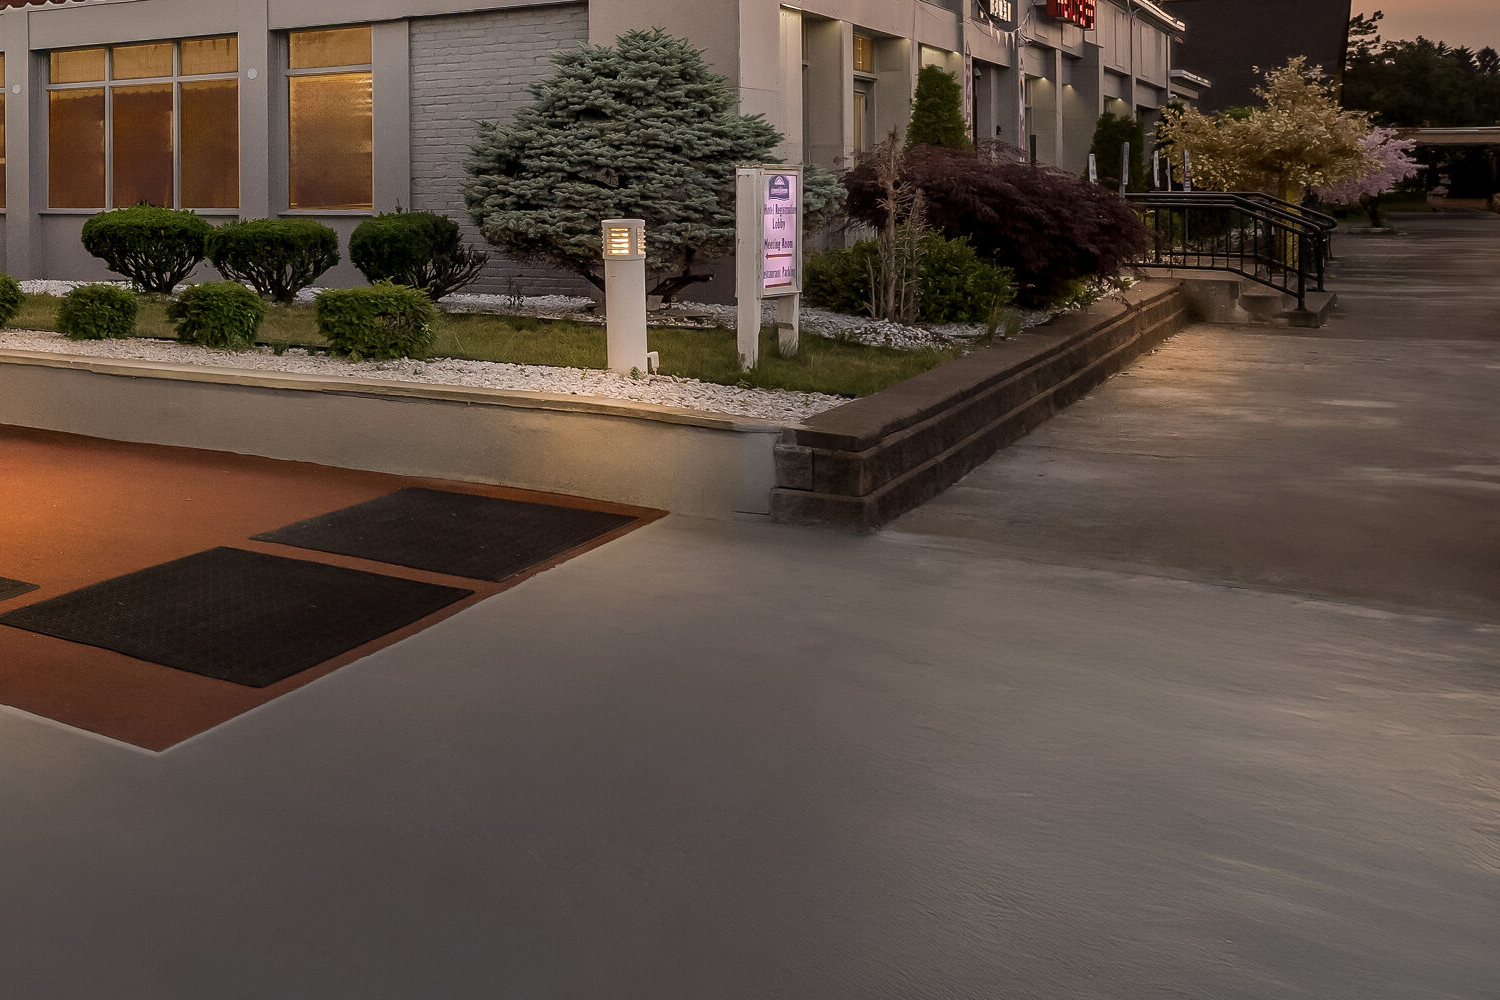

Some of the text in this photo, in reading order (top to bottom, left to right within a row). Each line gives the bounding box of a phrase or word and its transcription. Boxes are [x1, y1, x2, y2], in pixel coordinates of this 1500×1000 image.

[772, 217, 786, 230] Lobby
[764, 237, 794, 251] Meeting Room
[764, 269, 781, 279] estaurant
